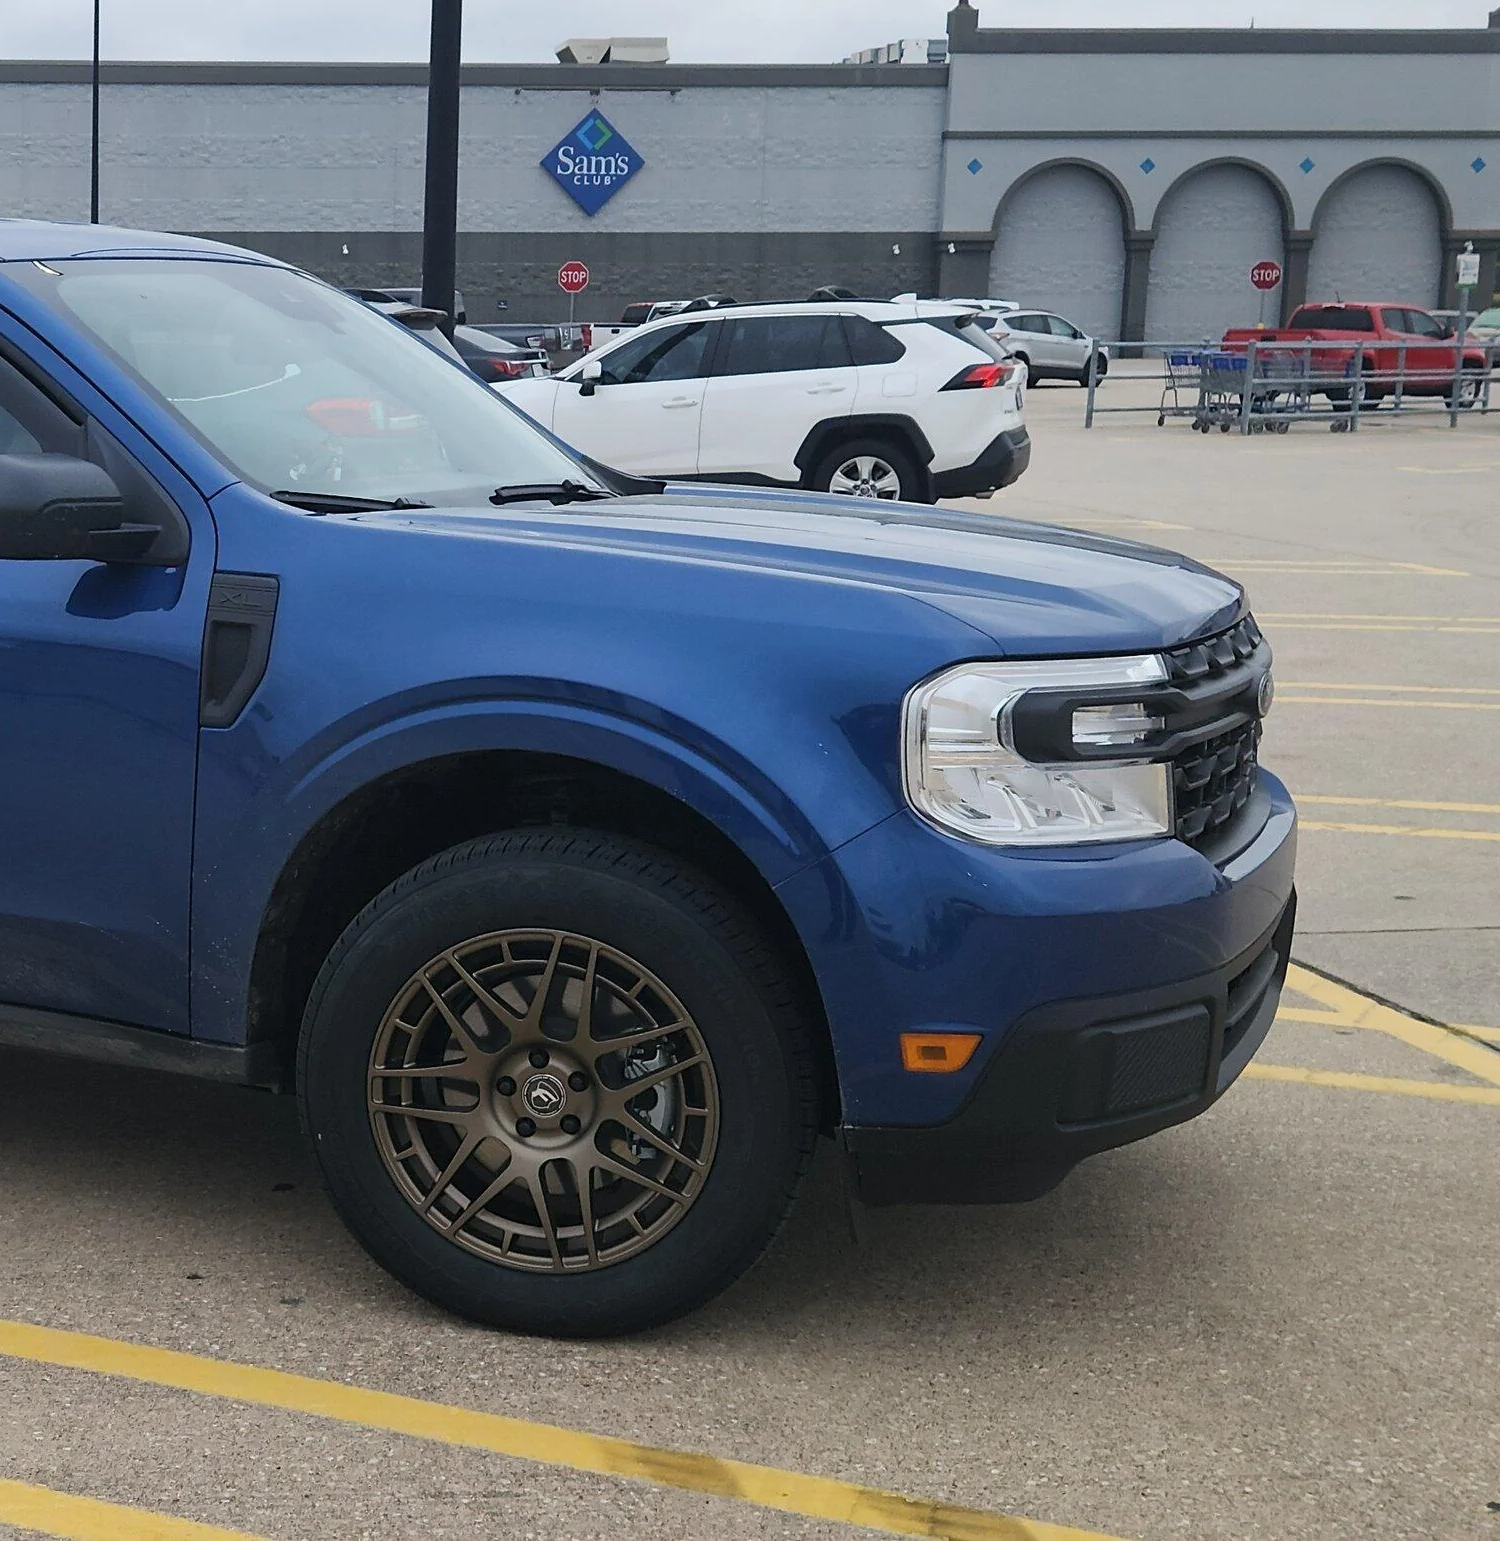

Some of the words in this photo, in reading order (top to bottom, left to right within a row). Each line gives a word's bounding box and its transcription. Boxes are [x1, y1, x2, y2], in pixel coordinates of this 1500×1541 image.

[557, 146, 629, 175] Sam's
[573, 175, 611, 185] CLUB
[561, 271, 586, 283] STOP
[1252, 269, 1280, 281] STOP
